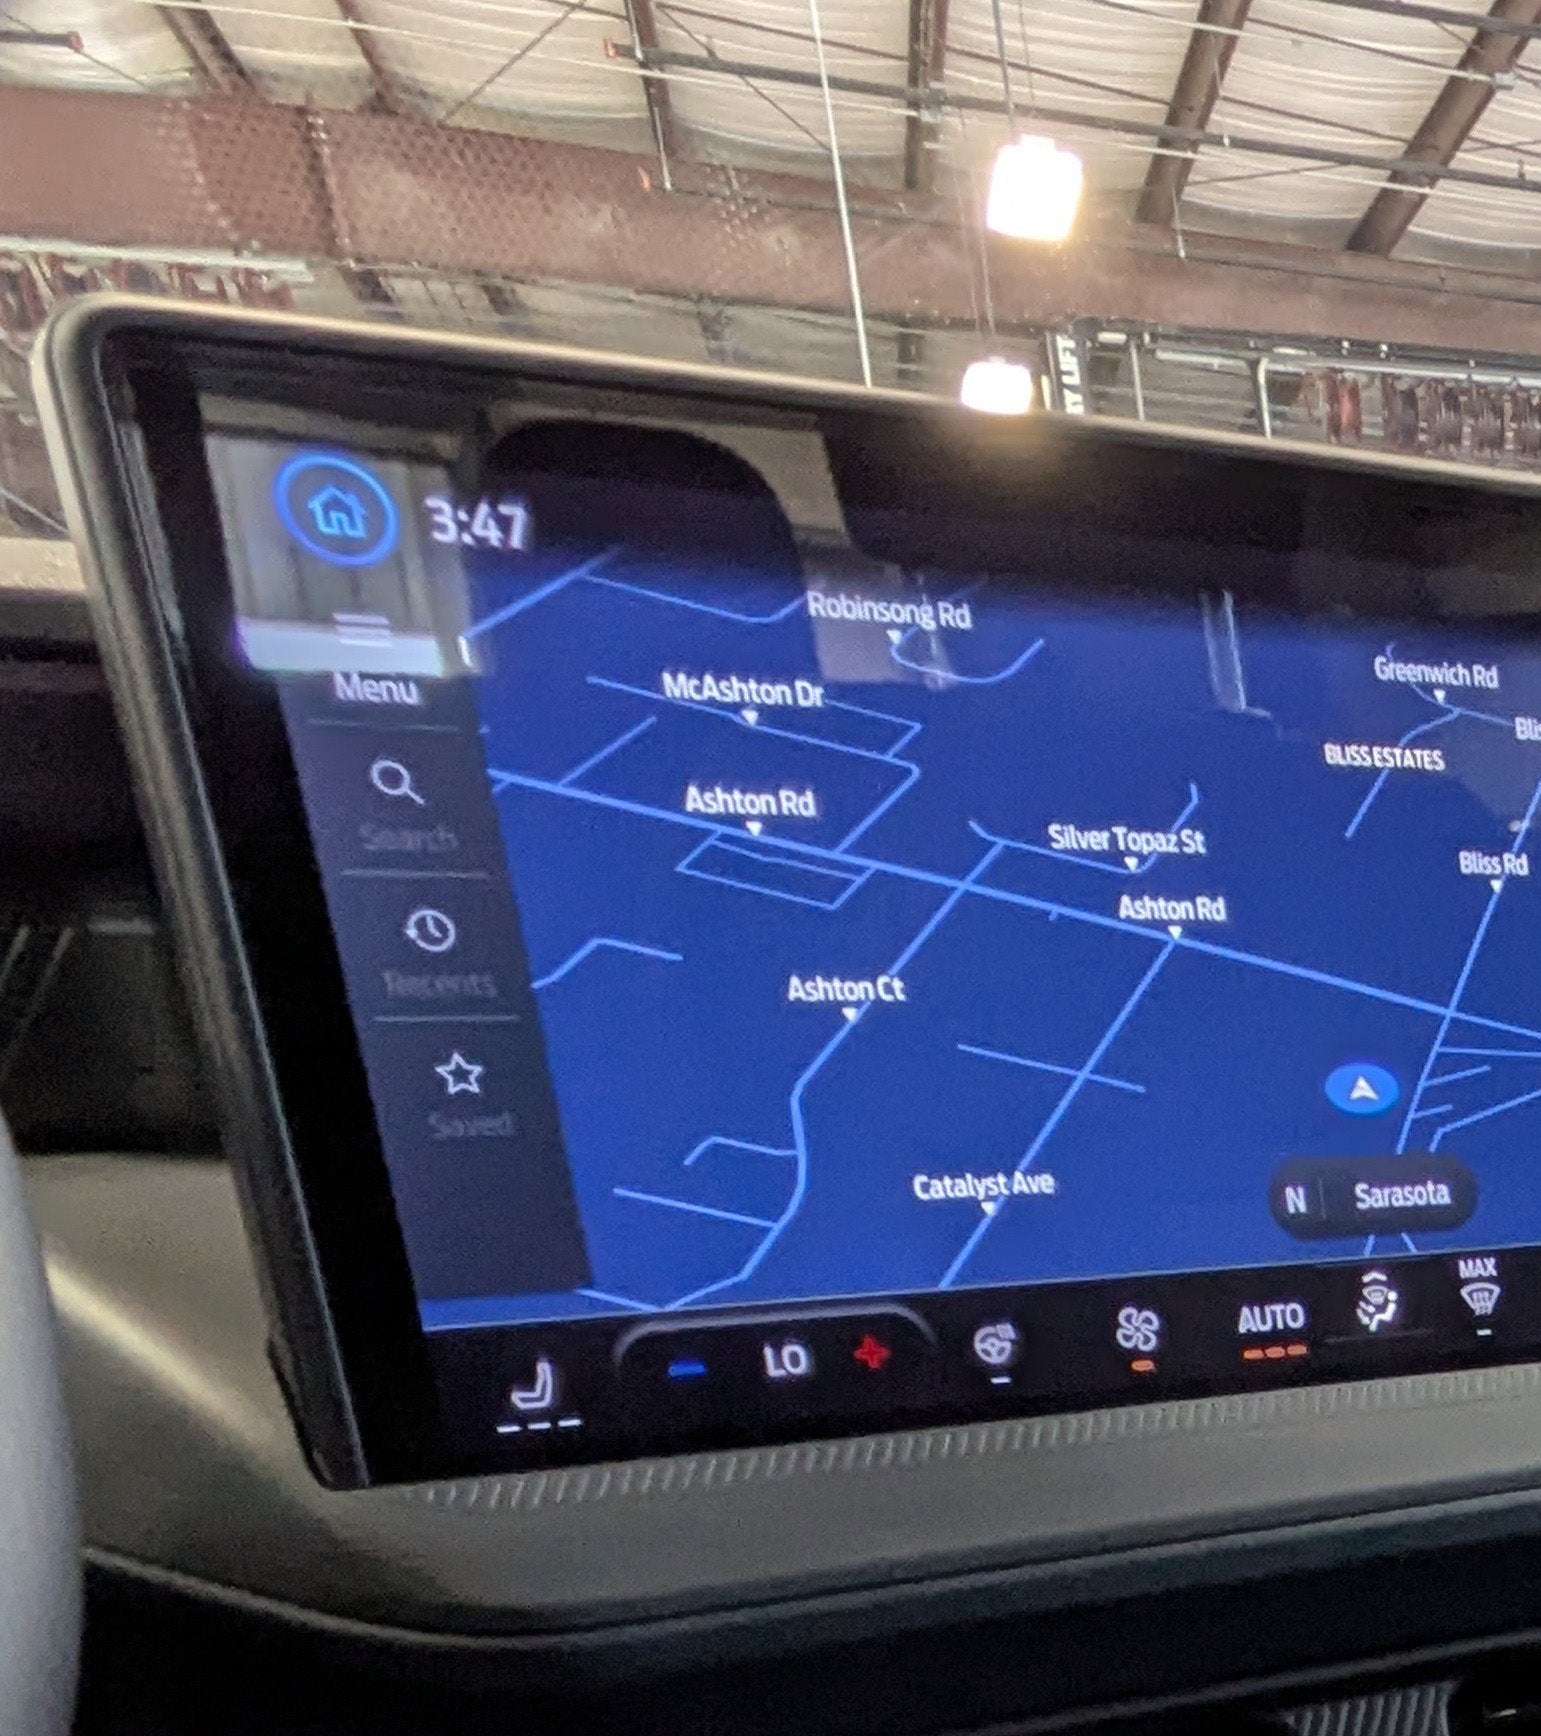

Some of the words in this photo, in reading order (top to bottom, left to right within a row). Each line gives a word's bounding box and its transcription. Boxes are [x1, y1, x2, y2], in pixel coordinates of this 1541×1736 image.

[424, 498, 530, 549] 3:47
[807, 591, 936, 630] Robinsong
[939, 601, 971, 630] Rd
[1374, 656, 1469, 688] Greenwich
[1473, 664, 1498, 690] Rd
[333, 672, 420, 705] Menu
[663, 672, 793, 706] McAshton
[796, 685, 825, 708] Dr
[1324, 743, 1373, 768] BLISS
[1373, 746, 1446, 772] ESTATES
[686, 784, 773, 815] Ashton
[778, 790, 816, 817] Rd
[1048, 825, 1110, 852] Silver
[1112, 828, 1179, 858] Topaz
[1181, 830, 1206, 855] St
[1459, 850, 1500, 875] Bliss
[1503, 852, 1529, 876] Rd
[1119, 896, 1191, 923] Ashton
[1194, 898, 1227, 922] Rd
[788, 976, 874, 1002] Ashton
[876, 978, 906, 1002] Ct
[913, 1172, 1008, 1200] Catalyst
[1012, 1171, 1056, 1195] Ave
[1285, 1186, 1307, 1214] N
[1355, 1182, 1452, 1210] Sarasota
[1458, 1258, 1497, 1278] MAX
[1239, 1304, 1306, 1334] AUTO
[762, 1343, 812, 1380] LO
